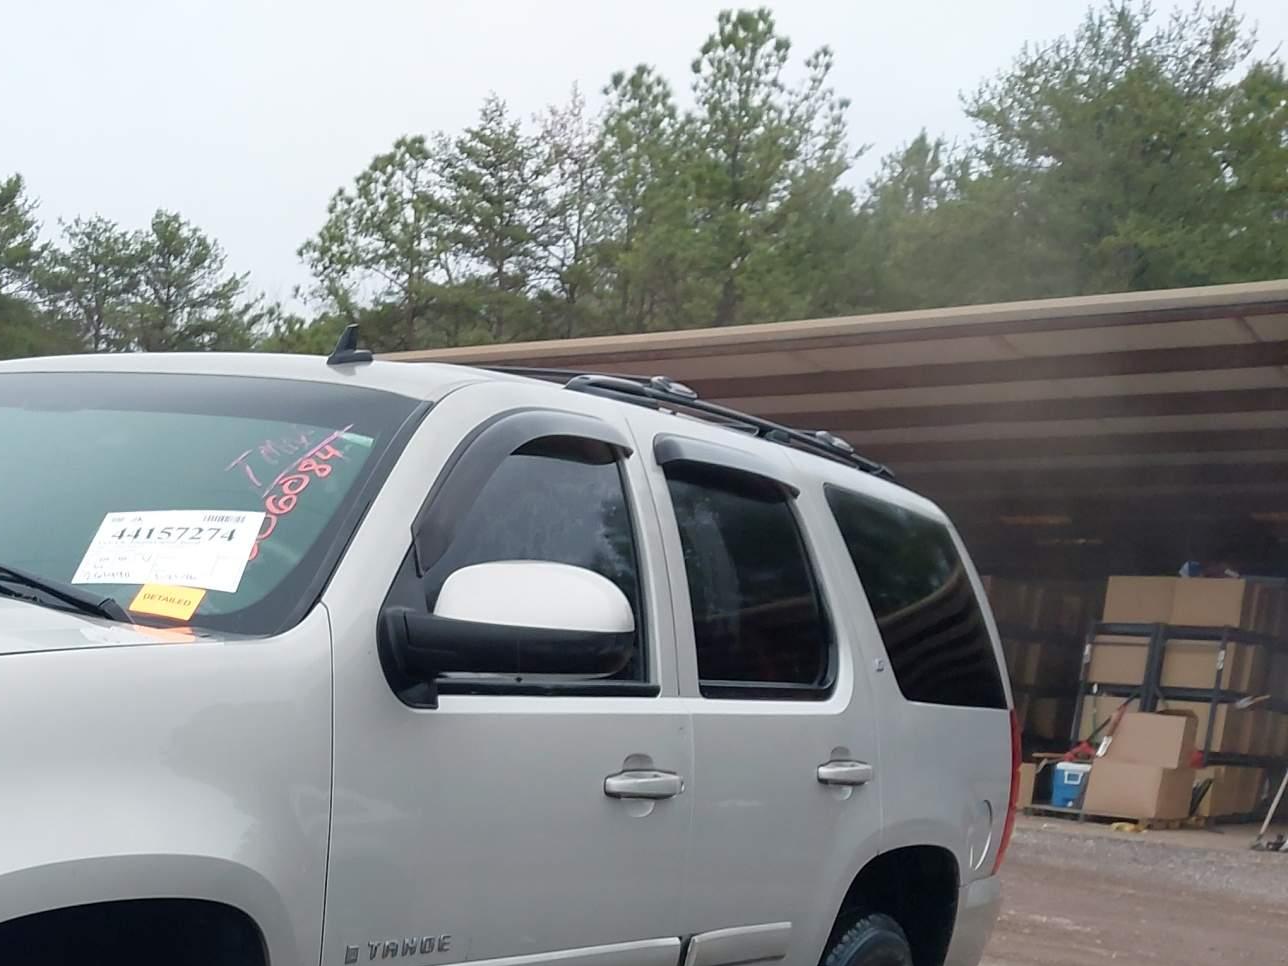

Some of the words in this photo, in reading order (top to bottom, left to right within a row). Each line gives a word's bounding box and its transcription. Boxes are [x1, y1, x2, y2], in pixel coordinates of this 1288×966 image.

[111, 526, 236, 542] 44157274
[143, 592, 191, 606] DETAILED
[368, 935, 451, 960] TAHOE
